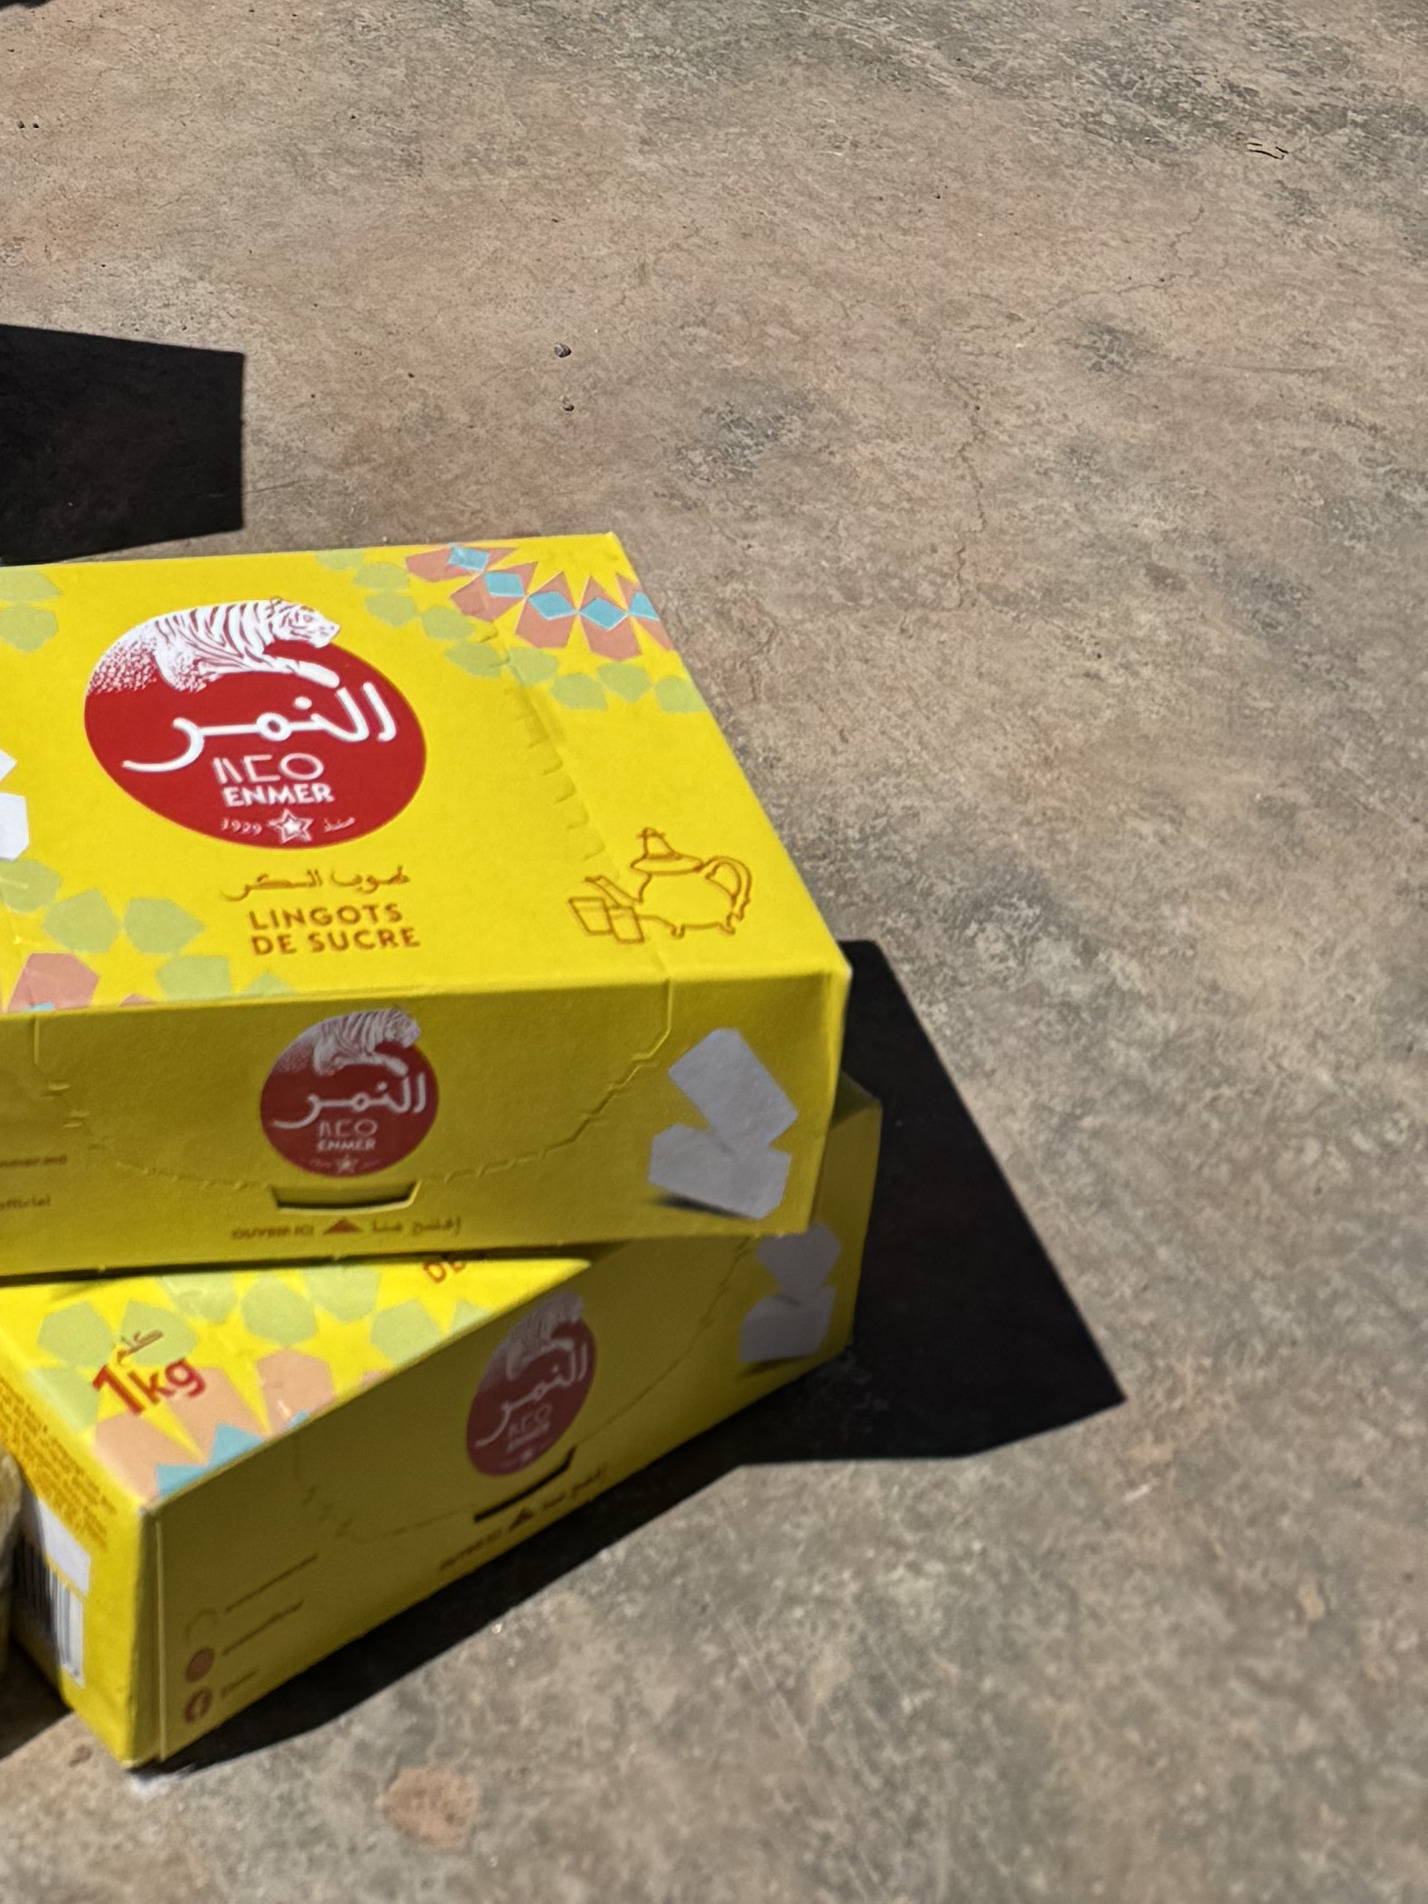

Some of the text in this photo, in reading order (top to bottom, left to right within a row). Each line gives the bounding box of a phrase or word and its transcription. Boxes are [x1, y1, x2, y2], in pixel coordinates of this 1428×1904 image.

[121, 678, 398, 773] النمر
[222, 782, 334, 807] ENMER
[220, 818, 262, 836] 1929
[248, 903, 404, 930] LINGOTS
[253, 927, 420, 956] DE SUCRE
[274, 1070, 427, 1130] النمر
[317, 1138, 377, 1152] ENMER
[91, 1356, 207, 1417] 1kg
[475, 1336, 589, 1450] النمر
